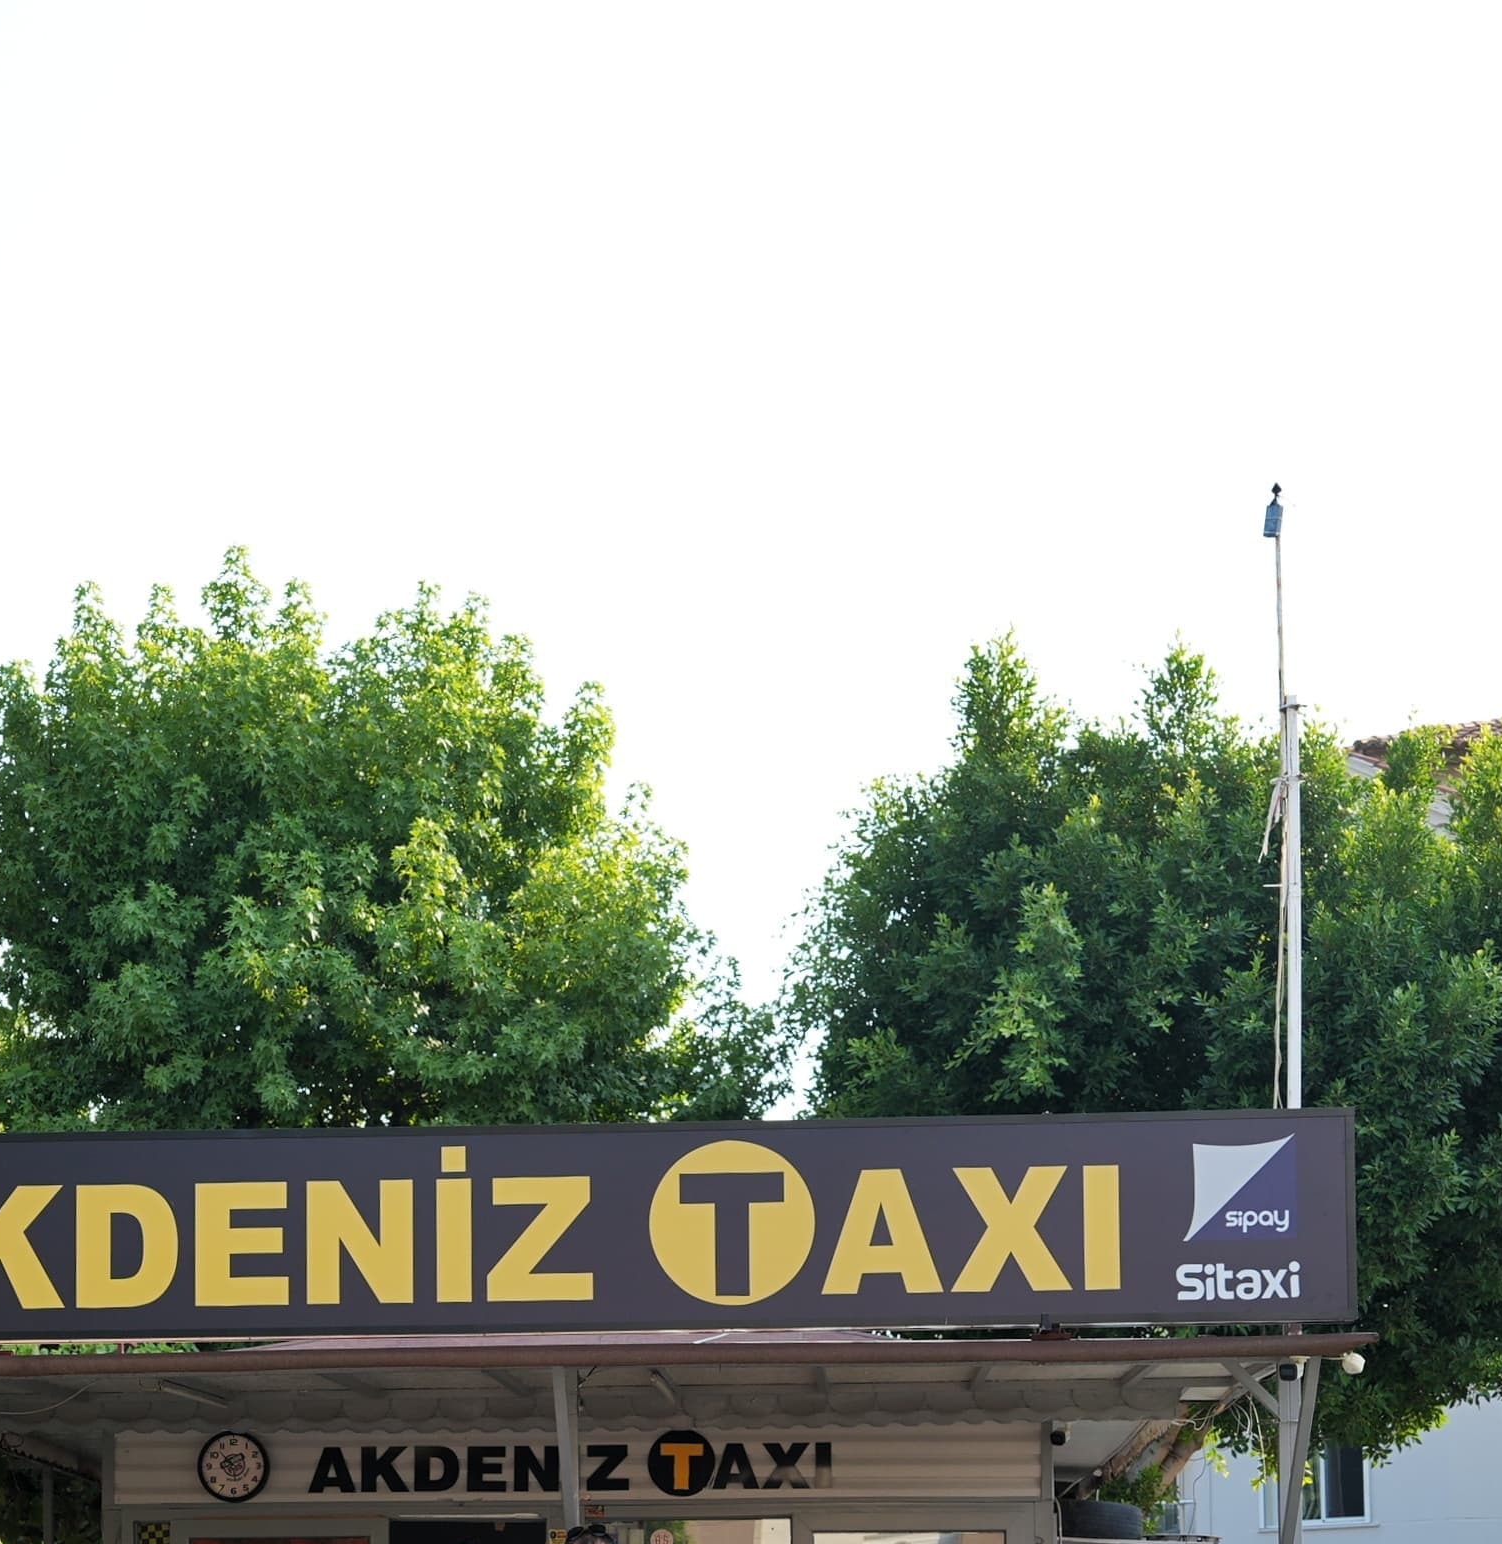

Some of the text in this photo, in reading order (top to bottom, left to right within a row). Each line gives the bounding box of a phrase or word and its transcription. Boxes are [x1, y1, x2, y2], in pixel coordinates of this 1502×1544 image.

[678, 1164, 1122, 1298] TAXI
[1225, 1209, 1290, 1233] sipay
[1175, 1260, 1301, 1301] Sitaxi
[308, 1445, 630, 1493] AKDENZ
[660, 1442, 832, 1491] TAXI
